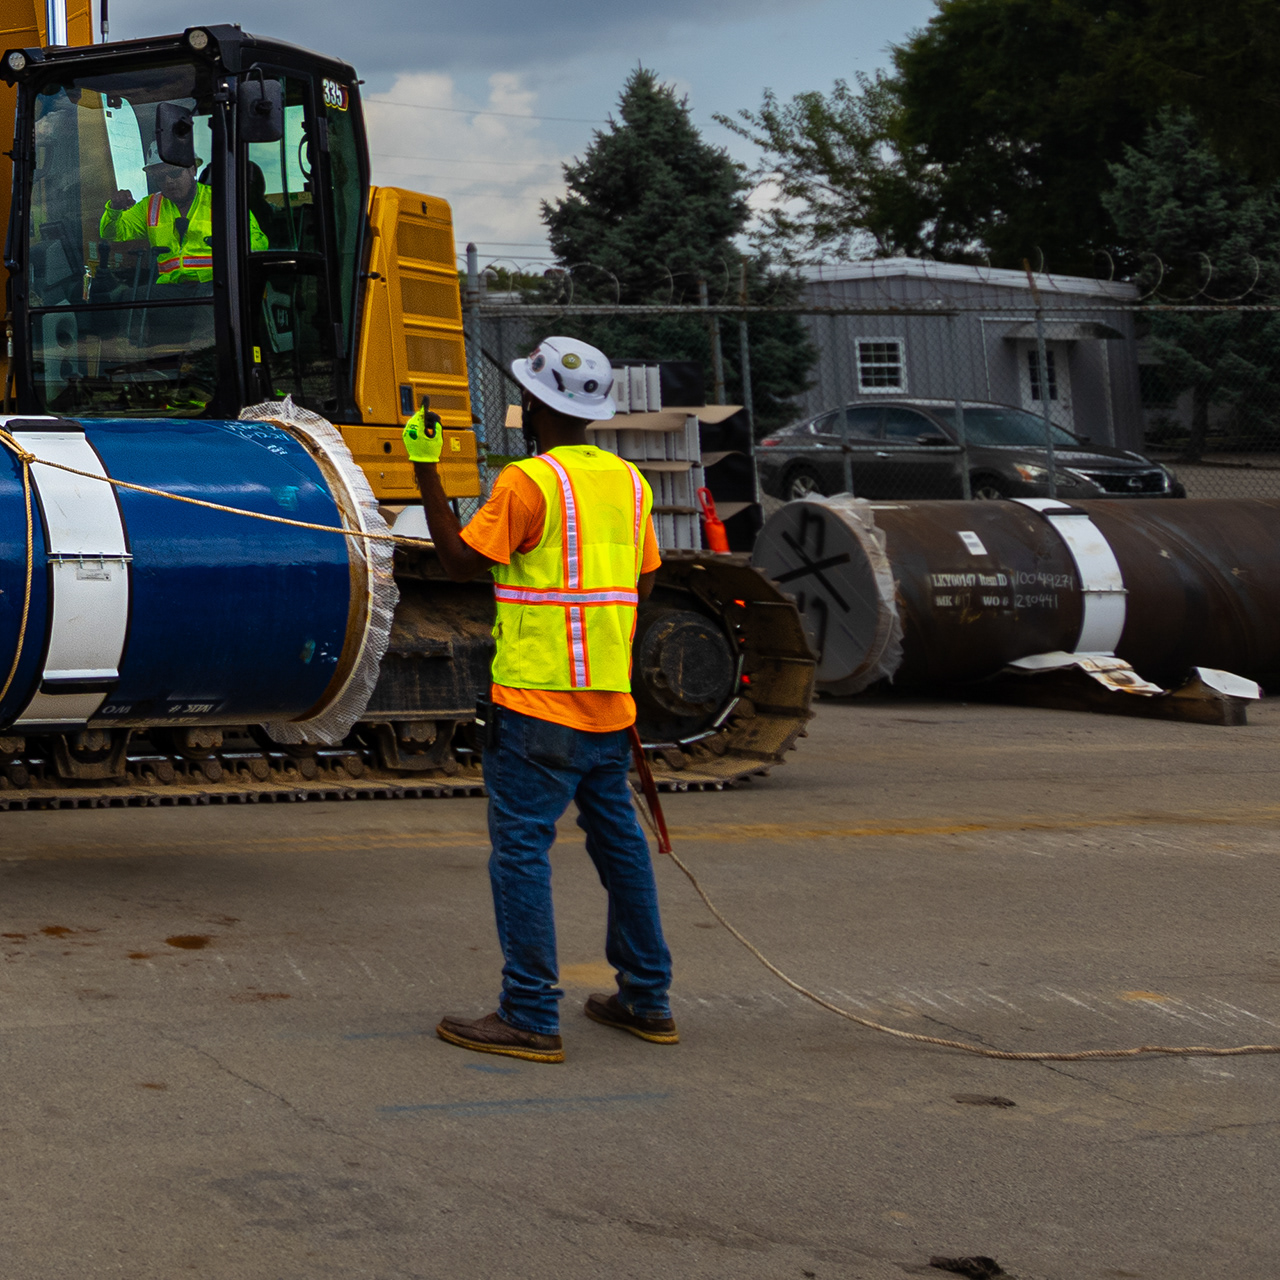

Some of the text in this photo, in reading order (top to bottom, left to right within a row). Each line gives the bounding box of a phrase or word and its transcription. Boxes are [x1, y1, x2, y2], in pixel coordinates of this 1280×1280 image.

[322, 78, 343, 107] 335
[978, 572, 998, 587] Item
[997, 572, 1008, 587] ID
[935, 595, 953, 607] MK
[982, 595, 1000, 607] WO
